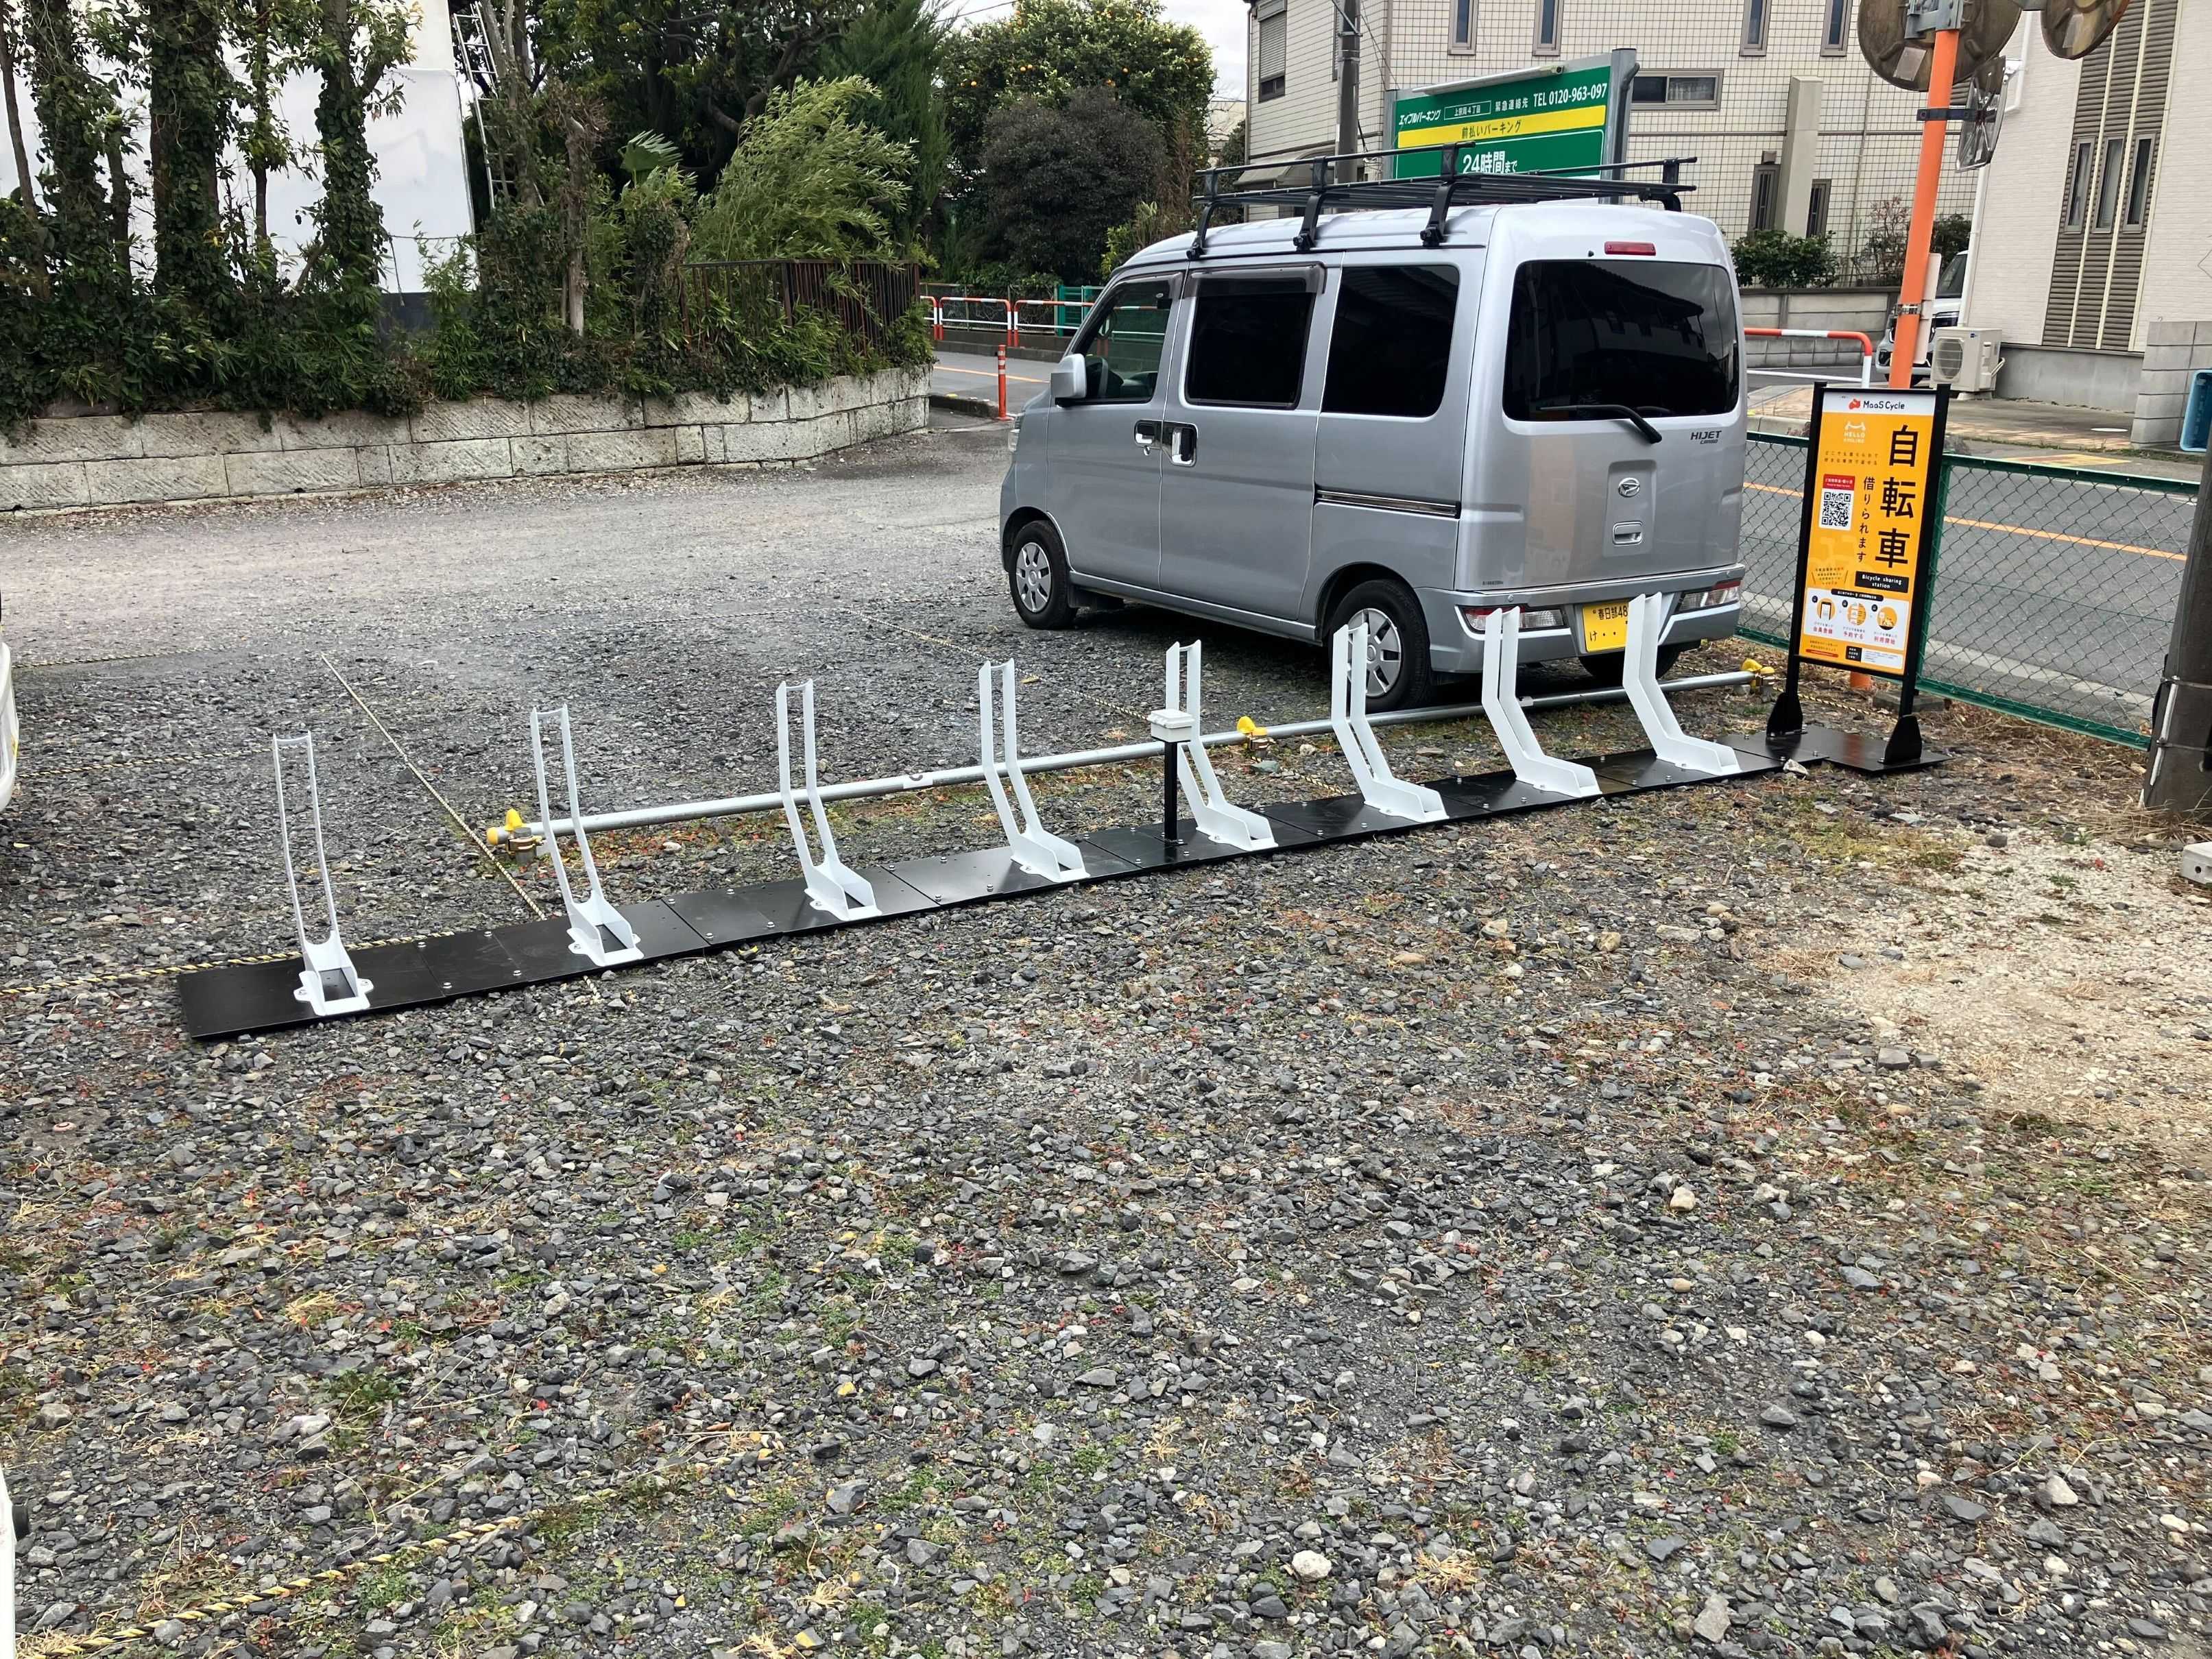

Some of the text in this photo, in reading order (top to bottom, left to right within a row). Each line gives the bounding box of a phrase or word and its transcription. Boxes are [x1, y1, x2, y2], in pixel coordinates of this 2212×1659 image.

[1533, 93, 1547, 107] TEL
[1549, 83, 1607, 105] 0120-963-097
[1461, 119, 1522, 139] 前払いパーキング
[1463, 150, 1517, 174] 24時間まで
[1863, 400, 1905, 411] MaaS Cycle
[1690, 430, 1722, 440] HIJET
[1875, 424, 1919, 568] 自転車
[1857, 476, 1875, 562] 借りられます
[1862, 574, 1902, 585] Bicycle sharing
